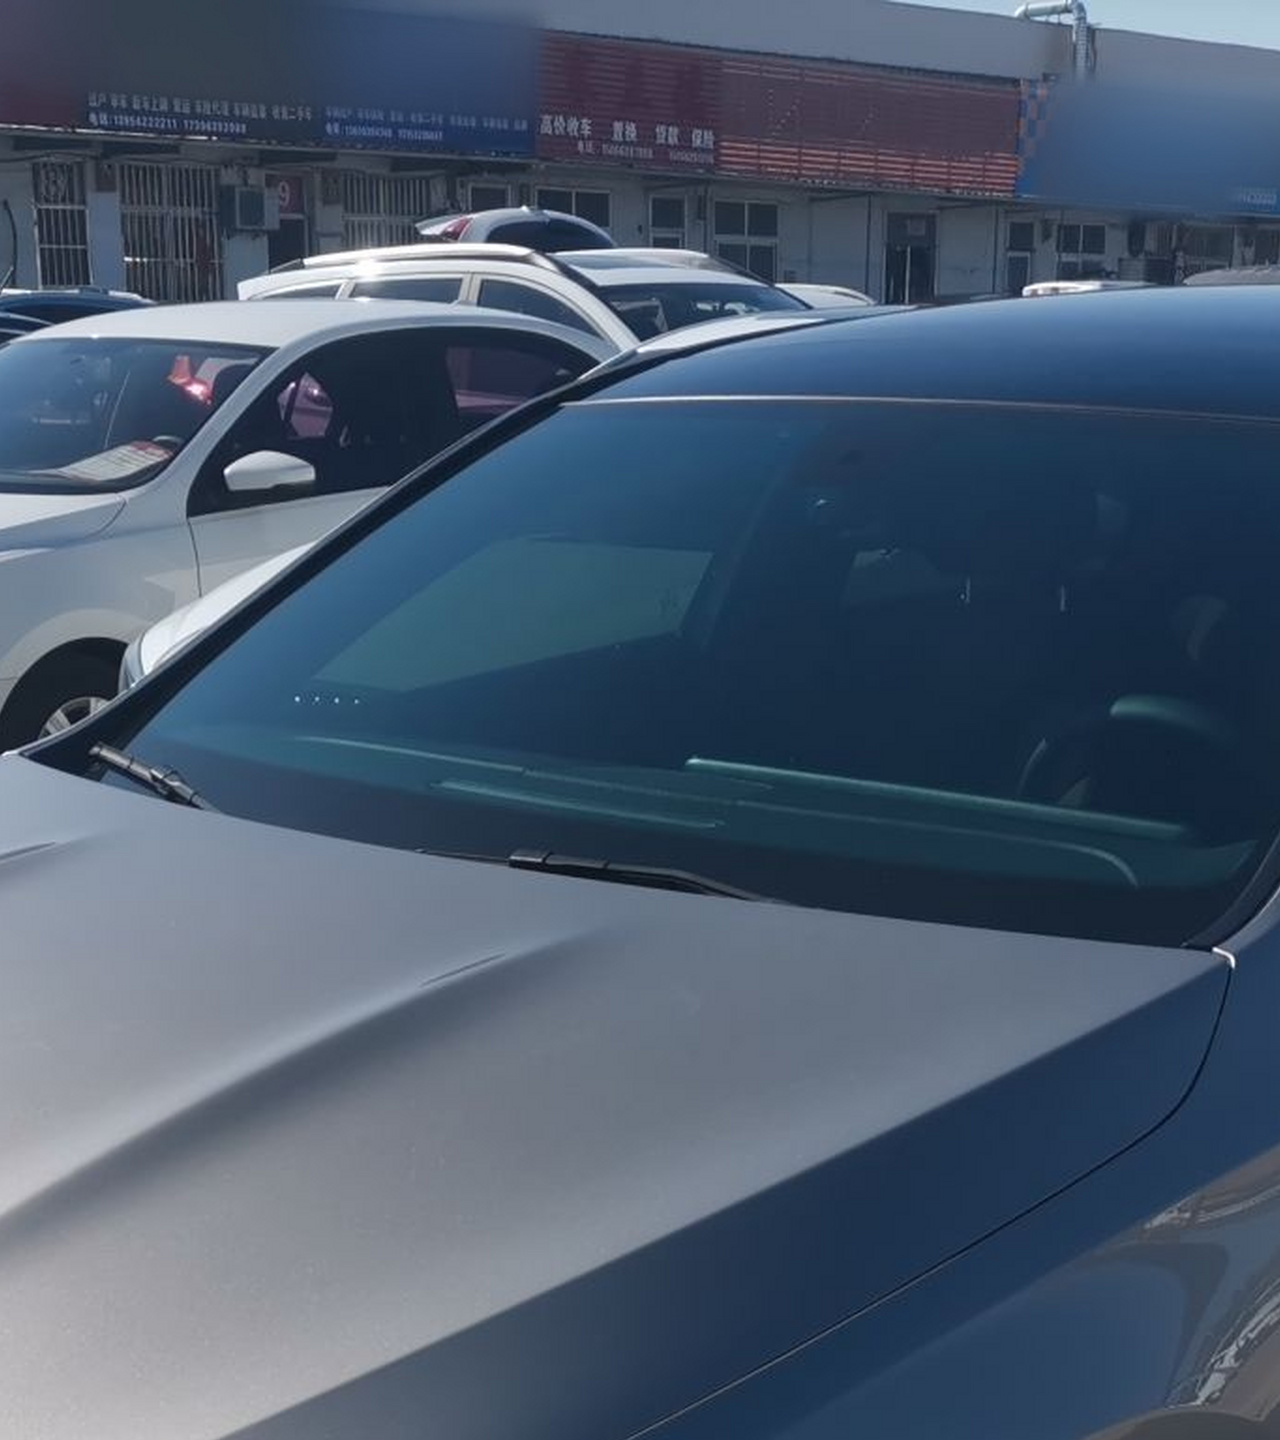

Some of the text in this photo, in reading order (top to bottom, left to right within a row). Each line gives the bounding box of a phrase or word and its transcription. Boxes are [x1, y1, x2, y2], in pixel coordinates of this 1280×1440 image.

[539, 114, 592, 138] 高价收车
[279, 181, 291, 206] 9
